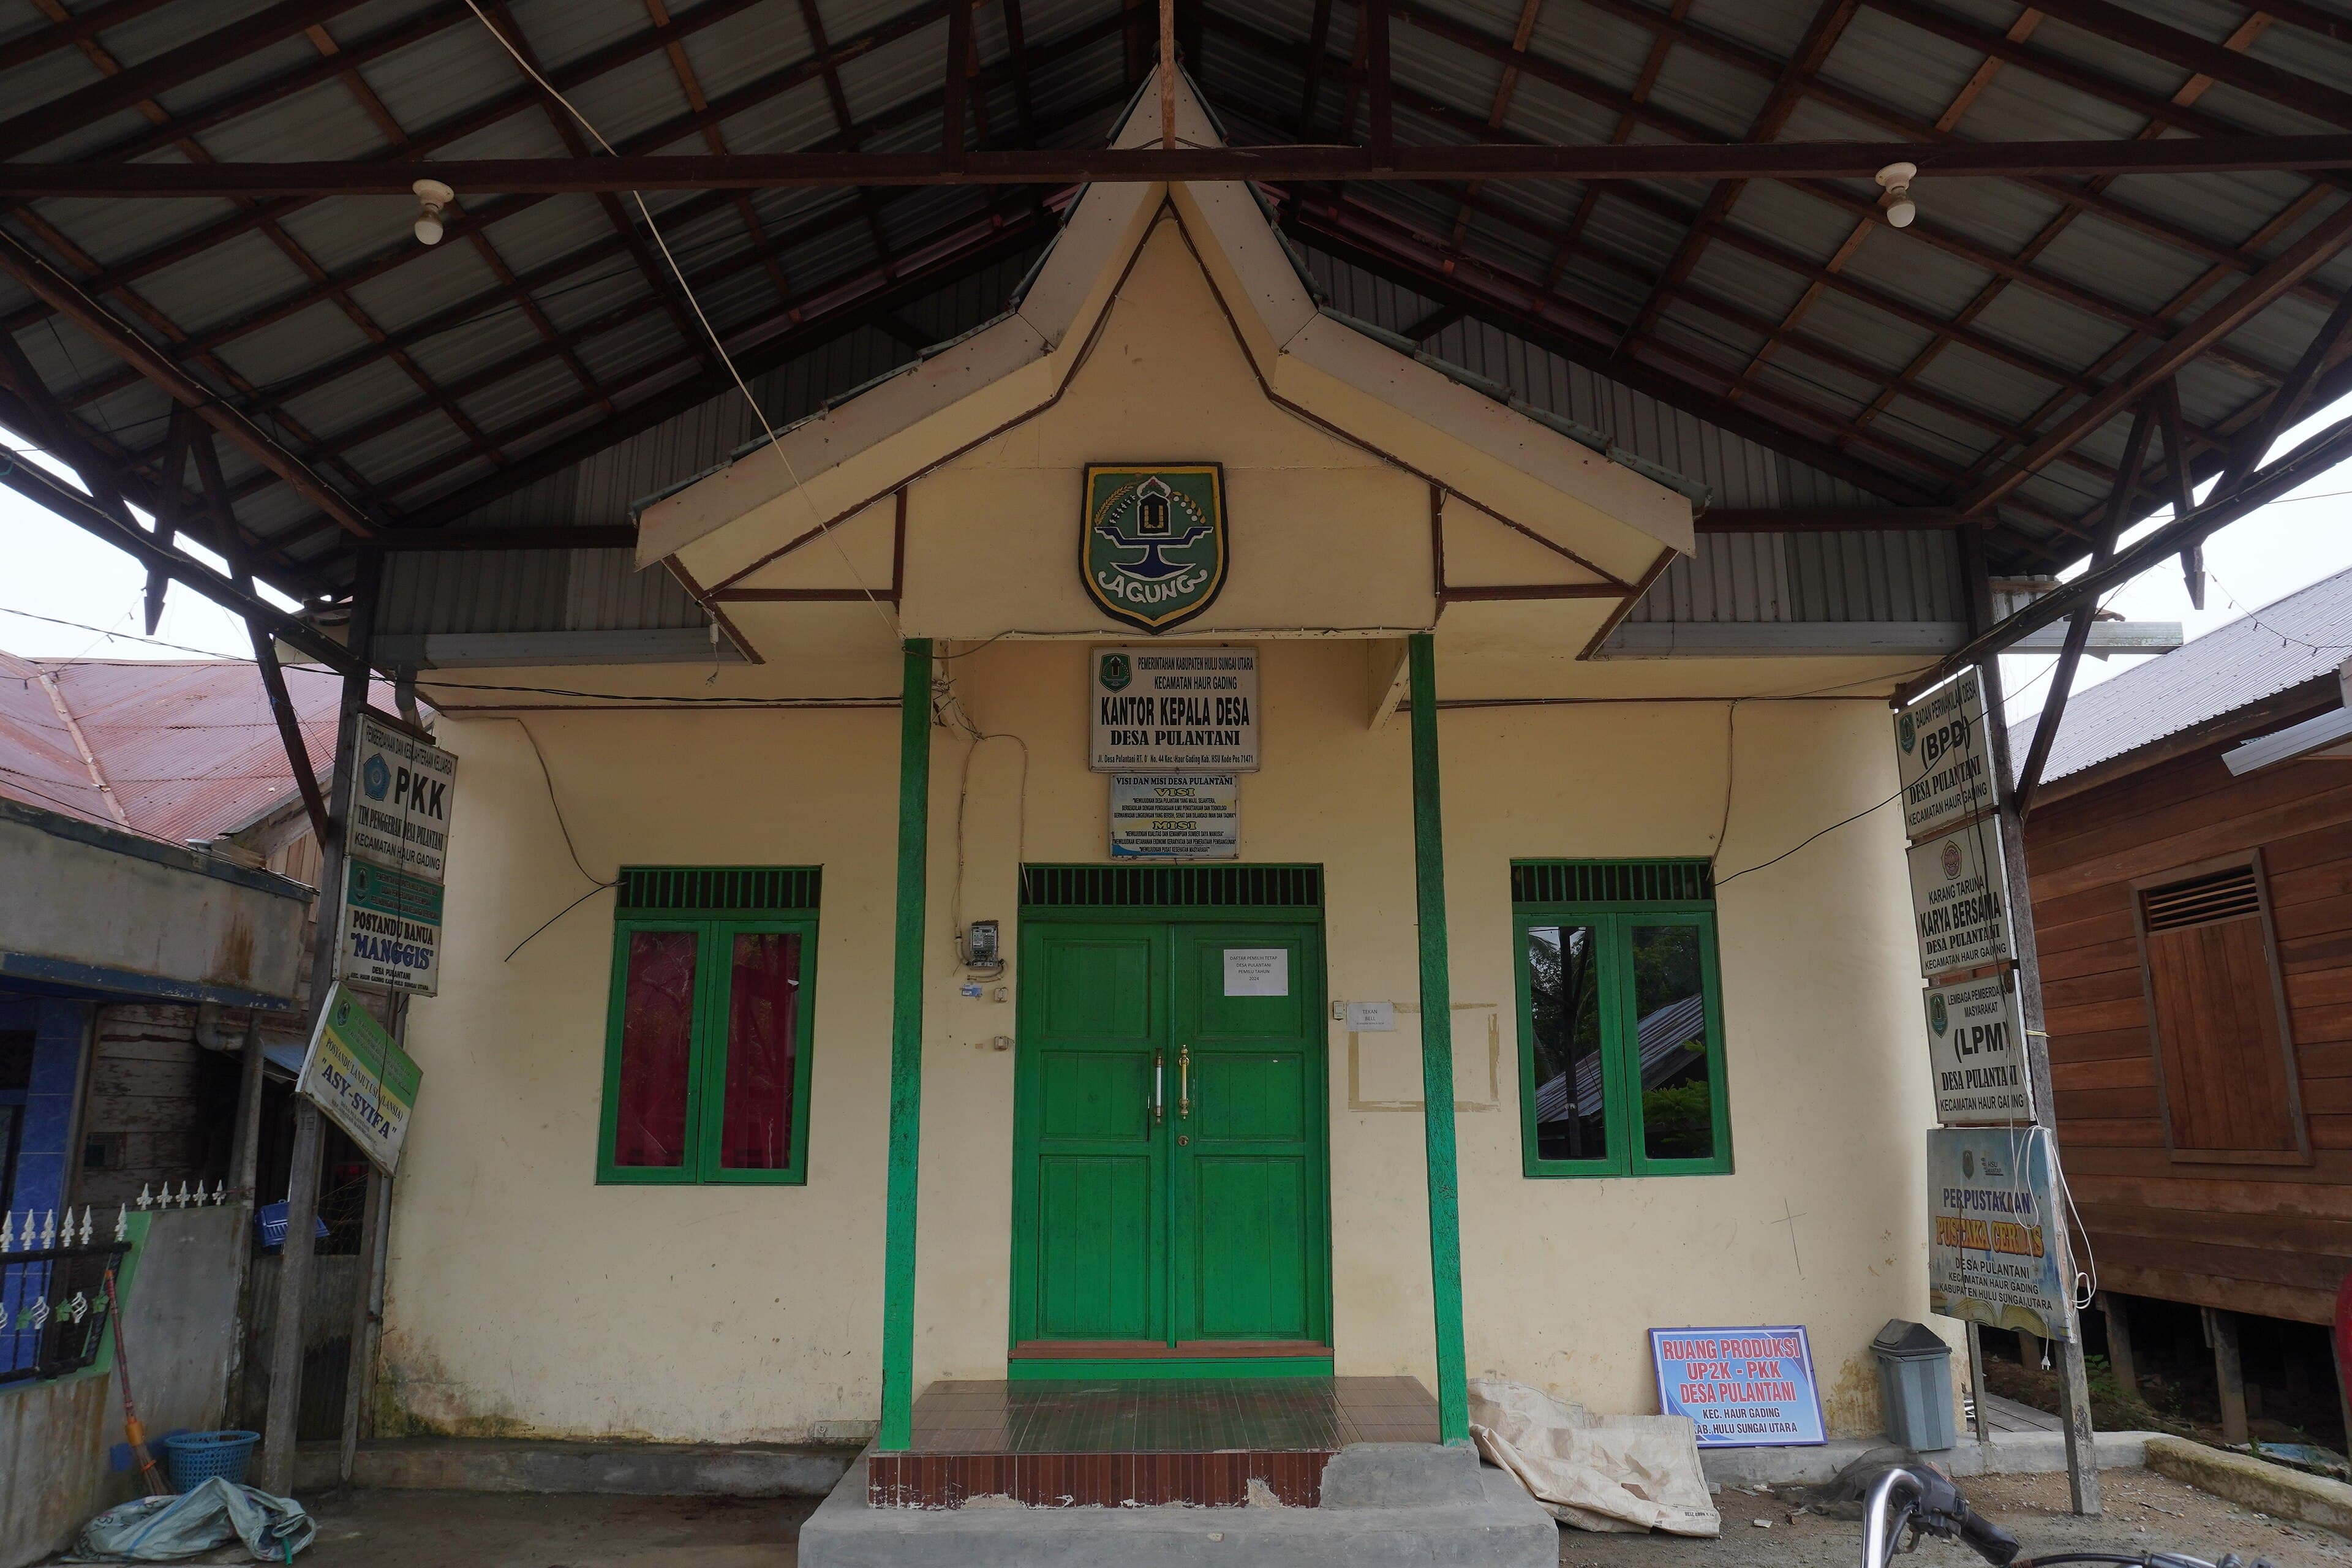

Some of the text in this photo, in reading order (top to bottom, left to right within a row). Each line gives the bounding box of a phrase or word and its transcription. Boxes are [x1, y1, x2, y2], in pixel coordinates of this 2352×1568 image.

[1098, 570, 1208, 603] AGUNG
[1138, 657, 1253, 670] PEMERINTAHAN KABUPATEN HULU SUNGAI UTARA
[1155, 676, 1237, 690] KECAMATAN HAUR GADING
[1101, 696, 1250, 726] KANTOR KEPALA DESA
[1916, 708, 1932, 729] BADAN
[1962, 680, 1977, 703] DESA
[1110, 730, 1240, 746] DESA PULANTANI
[1921, 715, 1971, 770] (BPD)
[1105, 755, 1115, 763] Desa
[1116, 755, 1136, 763] Pulantani
[1159, 755, 1164, 763] 44
[1175, 755, 1185, 763] Haur
[1186, 755, 1200, 764] Gading
[1201, 755, 1210, 763] Kab.
[1212, 755, 1220, 763] HSU
[1221, 755, 1231, 763] Kode
[1241, 755, 1253, 763] 71471
[1154, 788, 1195, 796] VISI
[1910, 755, 1981, 805] DESA PULANTANI
[394, 766, 446, 820] PKK
[1909, 802, 1944, 826] KECAMATAN
[1944, 794, 1961, 813] HAUR
[358, 805, 369, 826] TIM
[369, 810, 402, 838] PENGGERAK
[416, 824, 443, 851] PULANTANI
[1153, 821, 1196, 829] MISI
[355, 832, 440, 870] KECAMATAN HAUR GADING
[1928, 875, 1985, 905] KARANG TARUNA
[1920, 892, 2002, 938] KARYA BERSAMA
[353, 910, 434, 946] POSYANDU BANUA
[1926, 924, 2001, 955] DESA PULANTANI
[350, 932, 434, 970] "MANGGIS"
[1925, 955, 1960, 970] KECAMATAN
[1961, 949, 1978, 963] HAUR
[372, 966, 384, 976] DESA
[1948, 991, 1972, 1005] LEMBAGA
[1964, 1002, 1998, 1017] MASYARAKAT
[1954, 1018, 2010, 1063] (LPM)
[326, 1038, 352, 1071] POSYANDU
[350, 1064, 370, 1090] LANJUT
[381, 1095, 403, 1123] (LANSIA)
[1942, 1071, 1964, 1090] DESA
[1940, 1098, 1977, 1112] KECAMATAN
[1978, 1096, 1997, 1110] HAUR
[1936, 1216, 1991, 1251] PUSTAKA
[1955, 1257, 2030, 1279] DESA PULANTANI
[1949, 1272, 2038, 1295] KECAMATAN HAUR GADING
[1939, 1283, 2053, 1311] KABUPATEN HULU SUNGAI UTARA
[1662, 1336, 1800, 1361] RUANG PRODUKSI
[1686, 1361, 1732, 1381] UP2K
[1746, 1360, 1782, 1379] PKK
[1679, 1381, 1797, 1404] DESA PULANTANI
[1703, 1408, 1780, 1420] KEC. HAUR GADING
[1713, 1423, 1735, 1434] HULU
[1737, 1422, 1767, 1433] SUNGAI
[1769, 1422, 1798, 1433] UTARA
